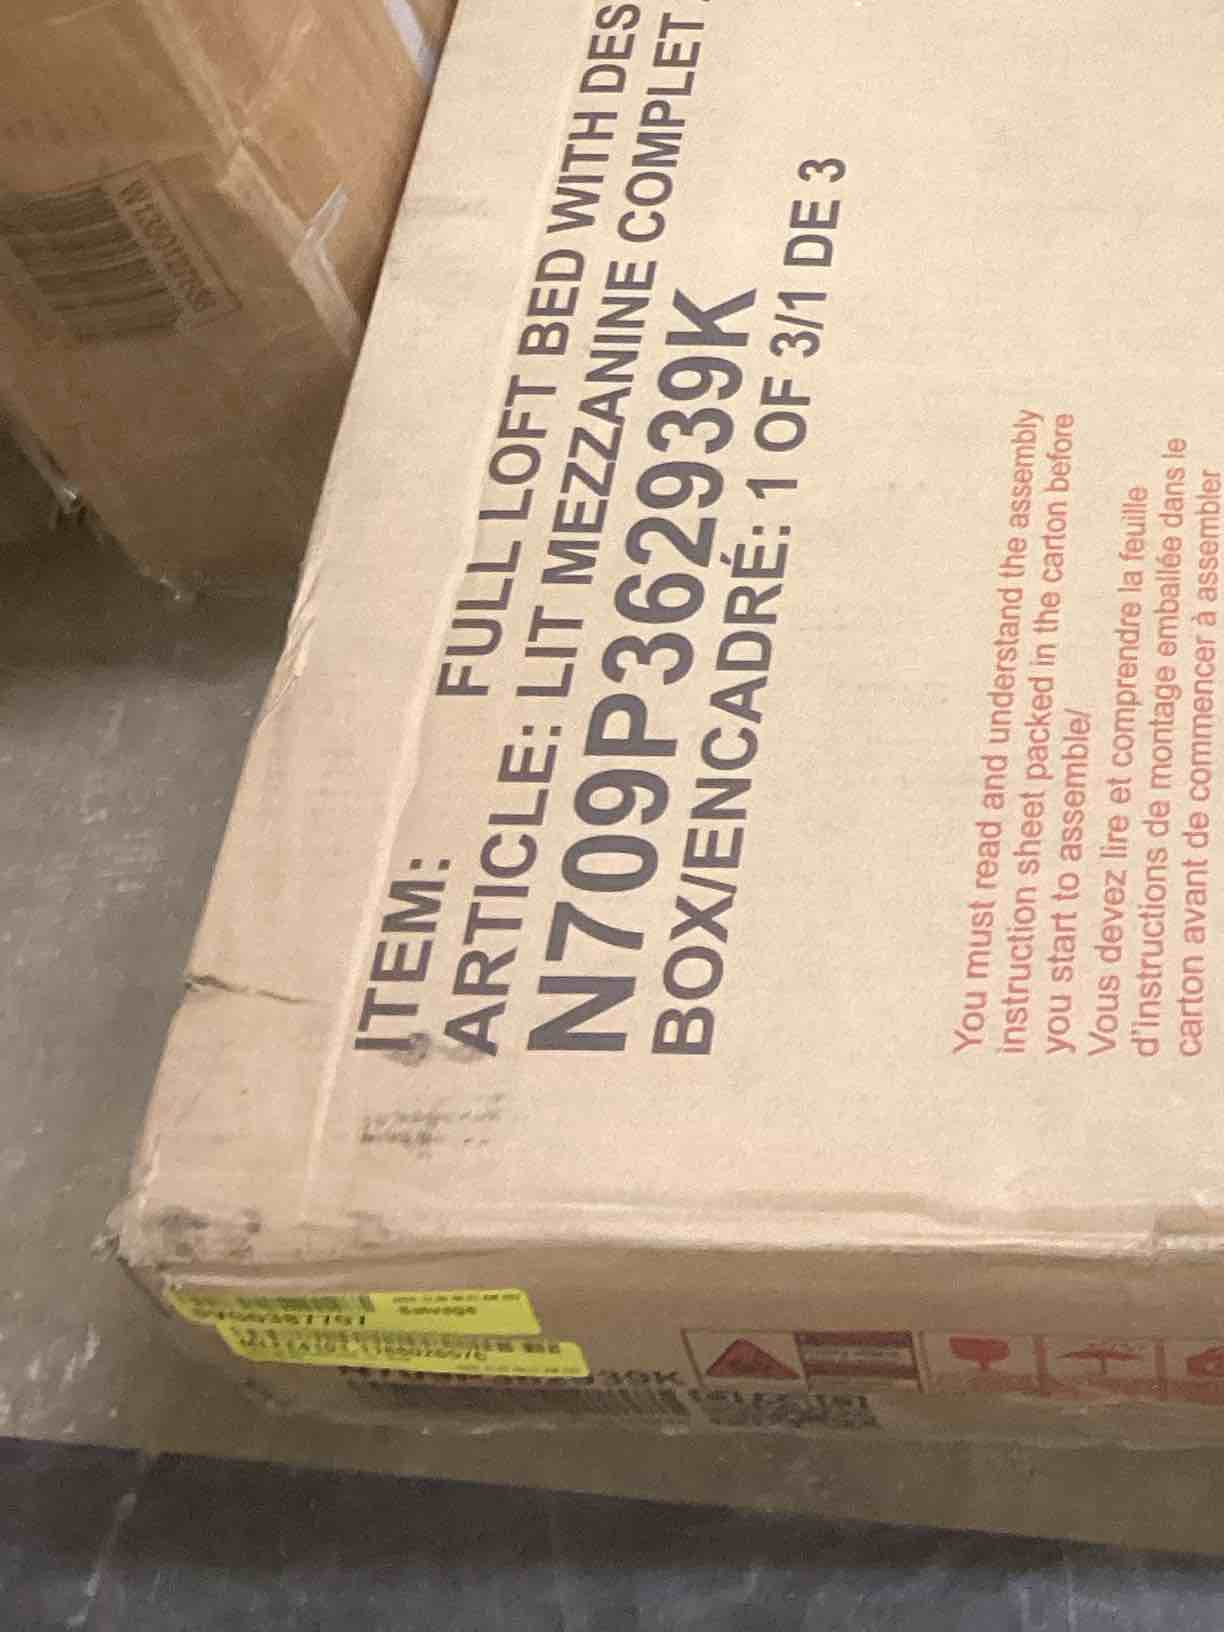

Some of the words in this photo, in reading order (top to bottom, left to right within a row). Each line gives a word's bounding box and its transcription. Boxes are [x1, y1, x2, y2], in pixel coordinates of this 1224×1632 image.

[618, 13, 704, 242] COMPLET
[546, 112, 618, 233] WITH
[798, 158, 845, 182] 3
[783, 200, 840, 266] DE
[518, 249, 585, 355] BED
[770, 292, 827, 357] 3/1
[478, 375, 554, 520] LOFT
[541, 261, 657, 584] MEZZANINE
[754, 377, 810, 452] OF
[1043, 414, 1074, 492] before
[1161, 438, 1187, 458] le
[746, 479, 797, 499] 1
[1009, 409, 1044, 528] assembly
[1158, 467, 1185, 528] dans
[999, 537, 1027, 578] the
[1041, 501, 1067, 583] carton
[1118, 486, 1148, 561] feuille
[1195, 469, 1221, 602] assembler
[435, 541, 521, 696] FULL
[1033, 592, 1061, 634] the
[1117, 571, 1143, 592] la
[1153, 536, 1182, 656] emballée
[1191, 611, 1216, 626] à
[516, 605, 583, 697] LIT
[526, 289, 756, 1051] N709P362939K
[987, 588, 1023, 743] understand
[1030, 644, 1056, 665] in
[1112, 602, 1142, 767] comprendre
[1024, 677, 1054, 780] packed
[1148, 666, 1182, 789] montage
[1189, 635, 1215, 802] commencer
[651, 526, 791, 1055] BOX/ENCADRÉ:
[981, 755, 1008, 810] and
[1060, 708, 1090, 861] assemble/
[1106, 777, 1132, 804] et
[1142, 800, 1170, 837] de
[975, 821, 1002, 889] read
[1013, 791, 1045, 875] sheet
[1100, 815, 1129, 858] lire
[1182, 812, 1209, 848] de
[447, 725, 561, 1062] ARTICLE:
[1051, 873, 1079, 901] to
[1094, 870, 1127, 963] devez
[1182, 859, 1208, 944] avant
[354, 859, 450, 1058] ITEM:
[967, 901, 995, 978] must
[997, 887, 1037, 1053] instruction
[1047, 912, 1077, 982] start
[1131, 848, 1168, 1057] d'instructions
[952, 992, 987, 1054] You
[1046, 995, 1076, 1054] you
[1088, 975, 1120, 1056] Vous
[1177, 956, 1204, 1057] carton
